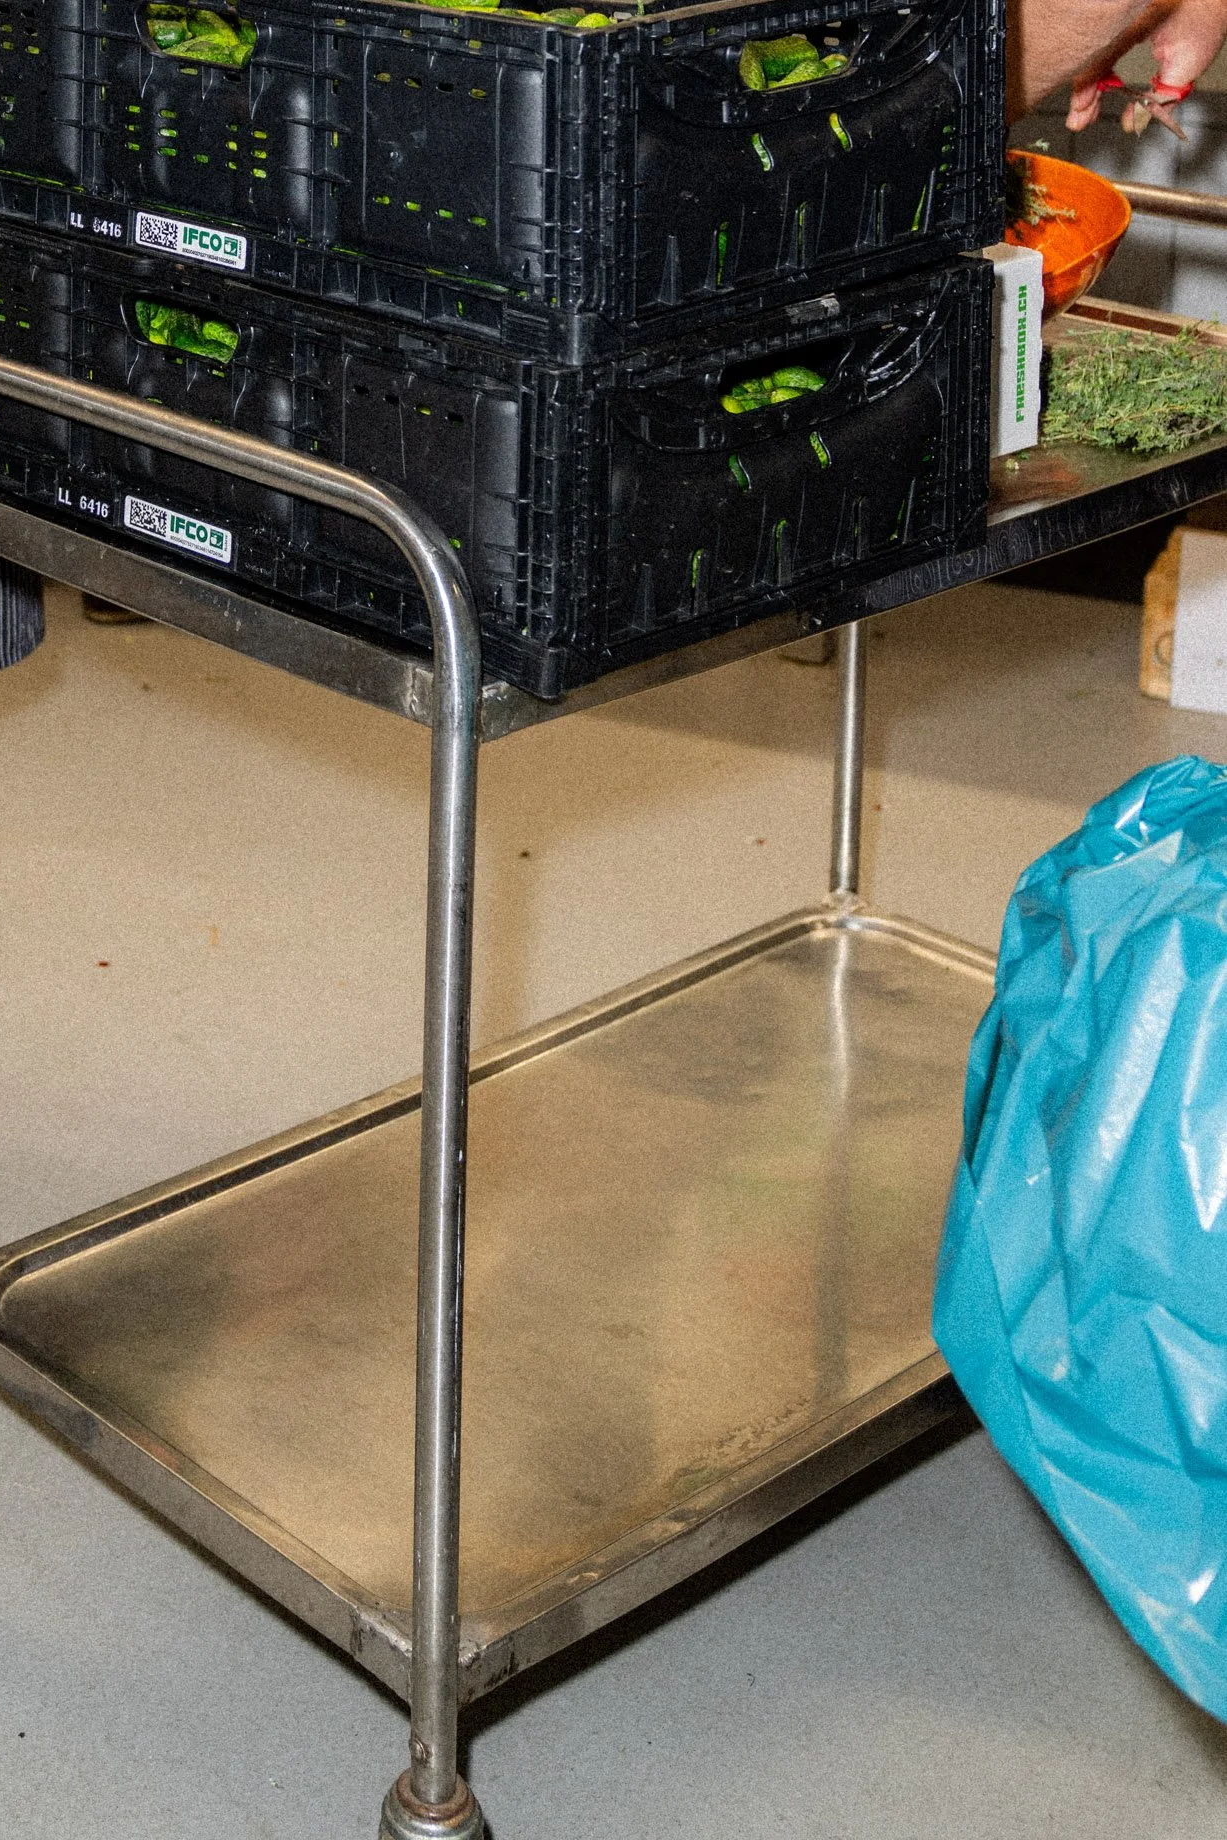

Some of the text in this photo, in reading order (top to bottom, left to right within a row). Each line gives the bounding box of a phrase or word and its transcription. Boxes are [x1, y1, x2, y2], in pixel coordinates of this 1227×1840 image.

[70, 212, 84, 229] LL
[182, 226, 222, 252] IFCO
[58, 487, 109, 518] LL 6416
[170, 515, 208, 543] IFCO
